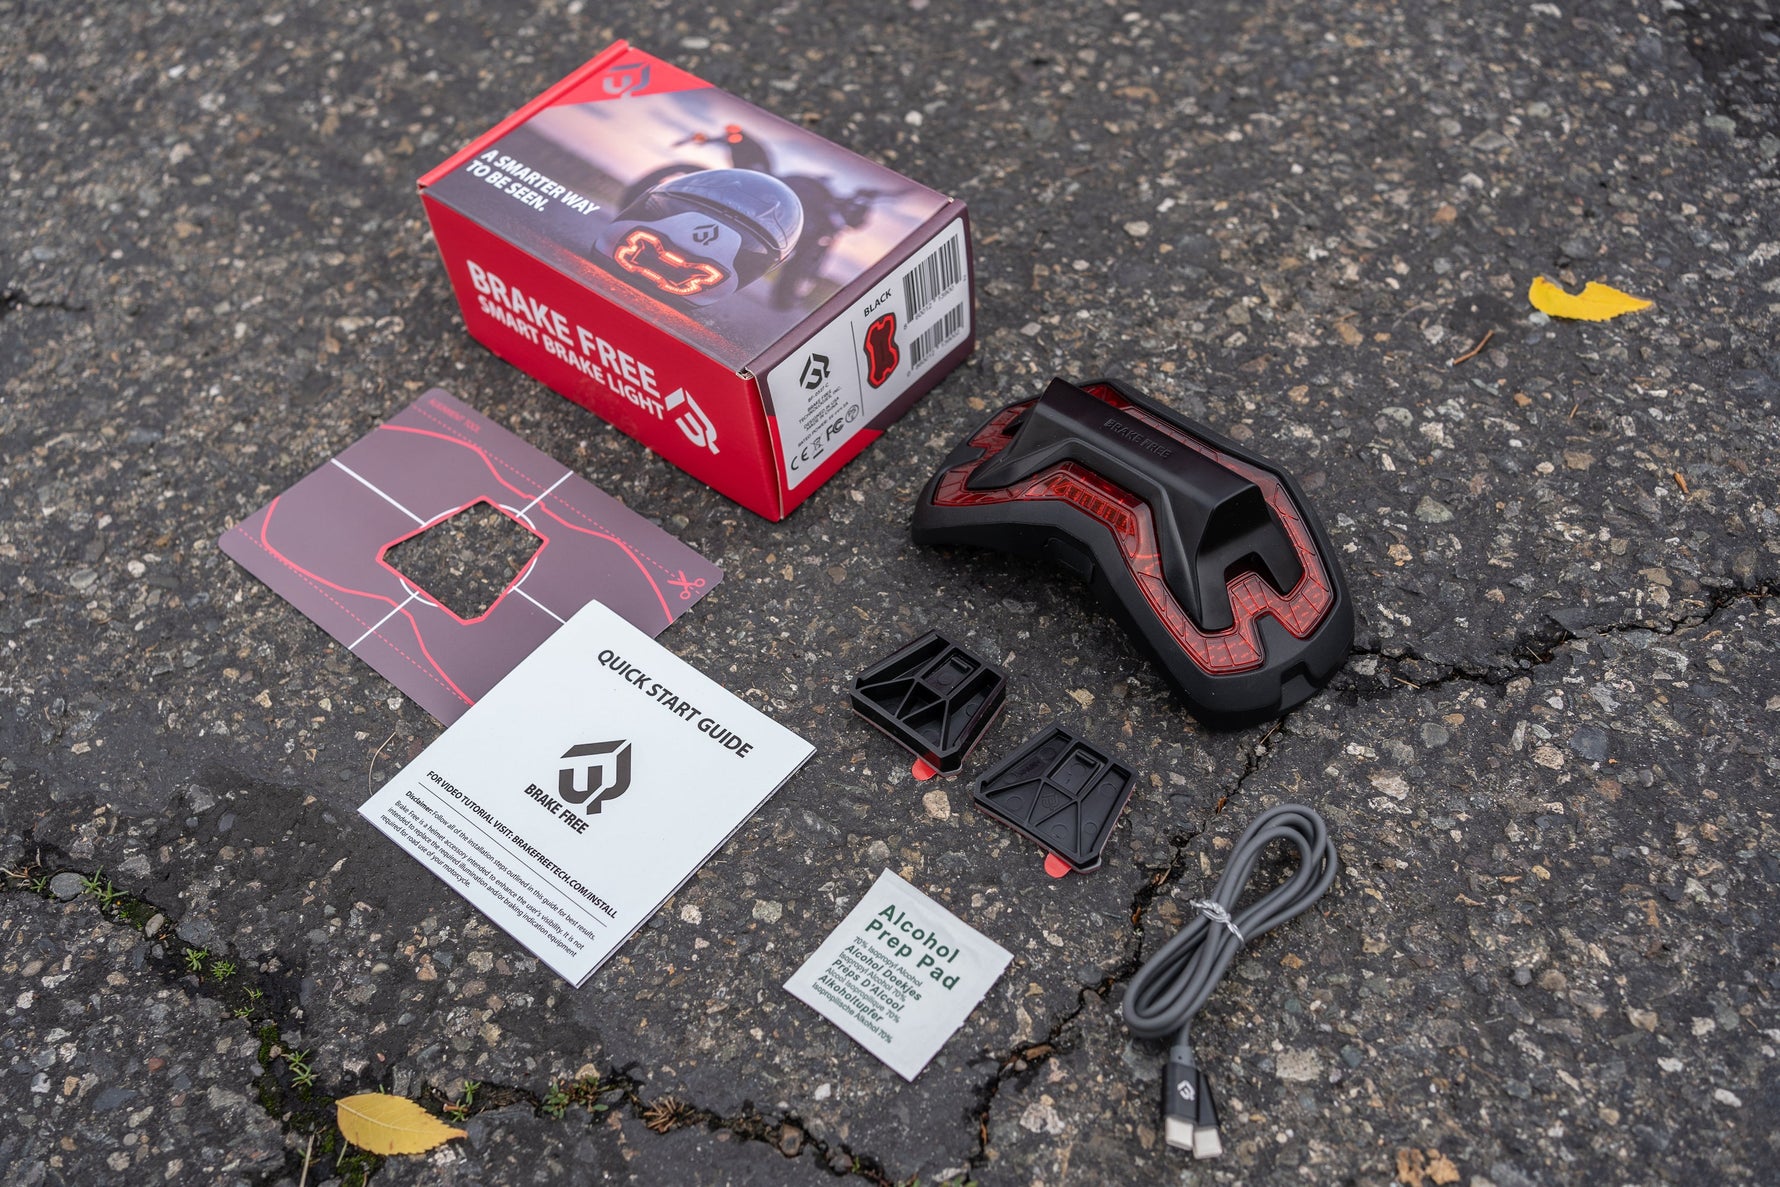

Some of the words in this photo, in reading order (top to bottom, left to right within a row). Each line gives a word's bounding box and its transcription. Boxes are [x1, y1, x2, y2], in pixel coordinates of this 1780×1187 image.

[466, 159, 491, 177] TO
[485, 171, 512, 189] BE
[504, 182, 549, 212] SEEN.
[481, 150, 499, 162] A
[494, 156, 566, 199] SMARTER
[561, 191, 601, 215] WAY
[466, 260, 575, 346] BRAKE
[575, 324, 661, 399] FREE
[864, 288, 892, 317] BLACK
[477, 294, 539, 345] SMART
[542, 333, 606, 386] BRAKE
[606, 373, 664, 420] LIGHT
[1103, 418, 1142, 443] BRAKE
[1141, 438, 1172, 458] FREE
[598, 650, 651, 689] QUICK
[645, 684, 702, 721] START
[697, 718, 754, 758] GUIDE
[524, 783, 563, 814] BRAKE
[558, 809, 589, 834] FREE
[380, 814, 403, 832] required
[399, 828, 409, 838] for
[406, 835, 421, 846] road
[417, 844, 428, 853] use
[430, 855, 444, 865] your
[442, 863, 471, 888] motorcycle.
[395, 800, 409, 813] Brake
[408, 810, 420, 821] Free
[427, 825, 445, 841] helmet
[444, 839, 468, 859] accessory
[466, 856, 491, 876] intended
[495, 880, 517, 898] enhance
[516, 895, 527, 905] the
[525, 903, 542, 917] user's
[541, 915, 564, 934] visibility.
[573, 940, 585, 950] not
[405, 790, 433, 814] Disclaimer:
[431, 810, 449, 826] Follow
[458, 832, 469, 841] the
[467, 838, 495, 861] installation
[493, 859, 508, 872] steps
[506, 870, 530, 888] outlined
[527, 884, 534, 892] in
[533, 890, 544, 900] this
[541, 898, 559, 912] guide
[557, 908, 567, 917] for
[565, 914, 579, 927] best
[576, 924, 596, 941] results.
[426, 770, 443, 784] FOR
[440, 780, 463, 799] VIDEO
[461, 795, 494, 824] TUTORIAL
[493, 820, 514, 839] VISIT:
[511, 835, 617, 919] BRAKEFREETECH.COM/INSTALL
[387, 807, 411, 826] intended
[413, 828, 432, 844] replace
[430, 840, 440, 850] the
[438, 848, 461, 865] required
[458, 862, 488, 888] illumination
[486, 886, 505, 901] and/or
[503, 897, 524, 917] braking
[522, 912, 548, 935] indication
[547, 933, 577, 957] equipment
[853, 936, 868, 949] 70%
[867, 945, 899, 969] Isopropyl
[896, 966, 923, 987] Alcohol
[865, 918, 912, 957] Prep
[916, 954, 960, 990] Pad
[878, 904, 960, 963] Alcohol
[818, 975, 883, 1022] Alkoholtupfer
[825, 967, 847, 983] Alcool
[845, 979, 885, 1012] Isopropilique
[885, 1009, 900, 1023] 70%
[839, 951, 869, 974] Isopropyl
[866, 971, 893, 991] Alcohol
[892, 988, 907, 1002] 70%
[844, 945, 884, 972] Alcohol
[882, 969, 922, 1001] Doekjes
[812, 982, 855, 1016] Isopropilische
[854, 1012, 880, 1033] Alkohol
[878, 1029, 893, 1044] 70%
